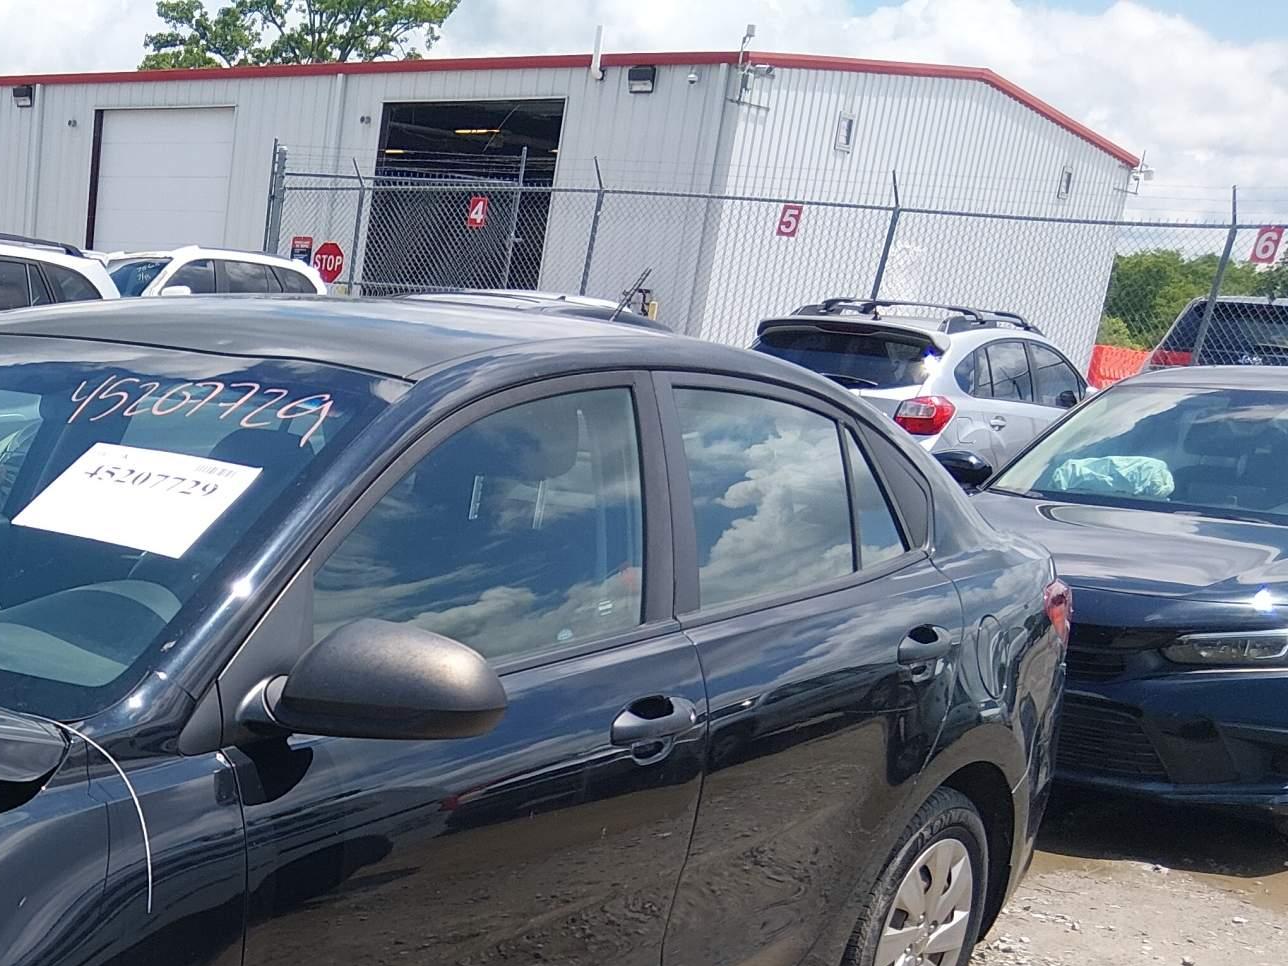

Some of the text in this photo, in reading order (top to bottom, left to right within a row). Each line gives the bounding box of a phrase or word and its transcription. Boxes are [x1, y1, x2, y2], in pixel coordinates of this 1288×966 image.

[470, 200, 484, 224] 4
[780, 209, 799, 233] 5
[1255, 231, 1279, 259] 6
[314, 254, 343, 272] STOP
[67, 374, 335, 448] 45207729
[84, 464, 219, 497] 45207729
